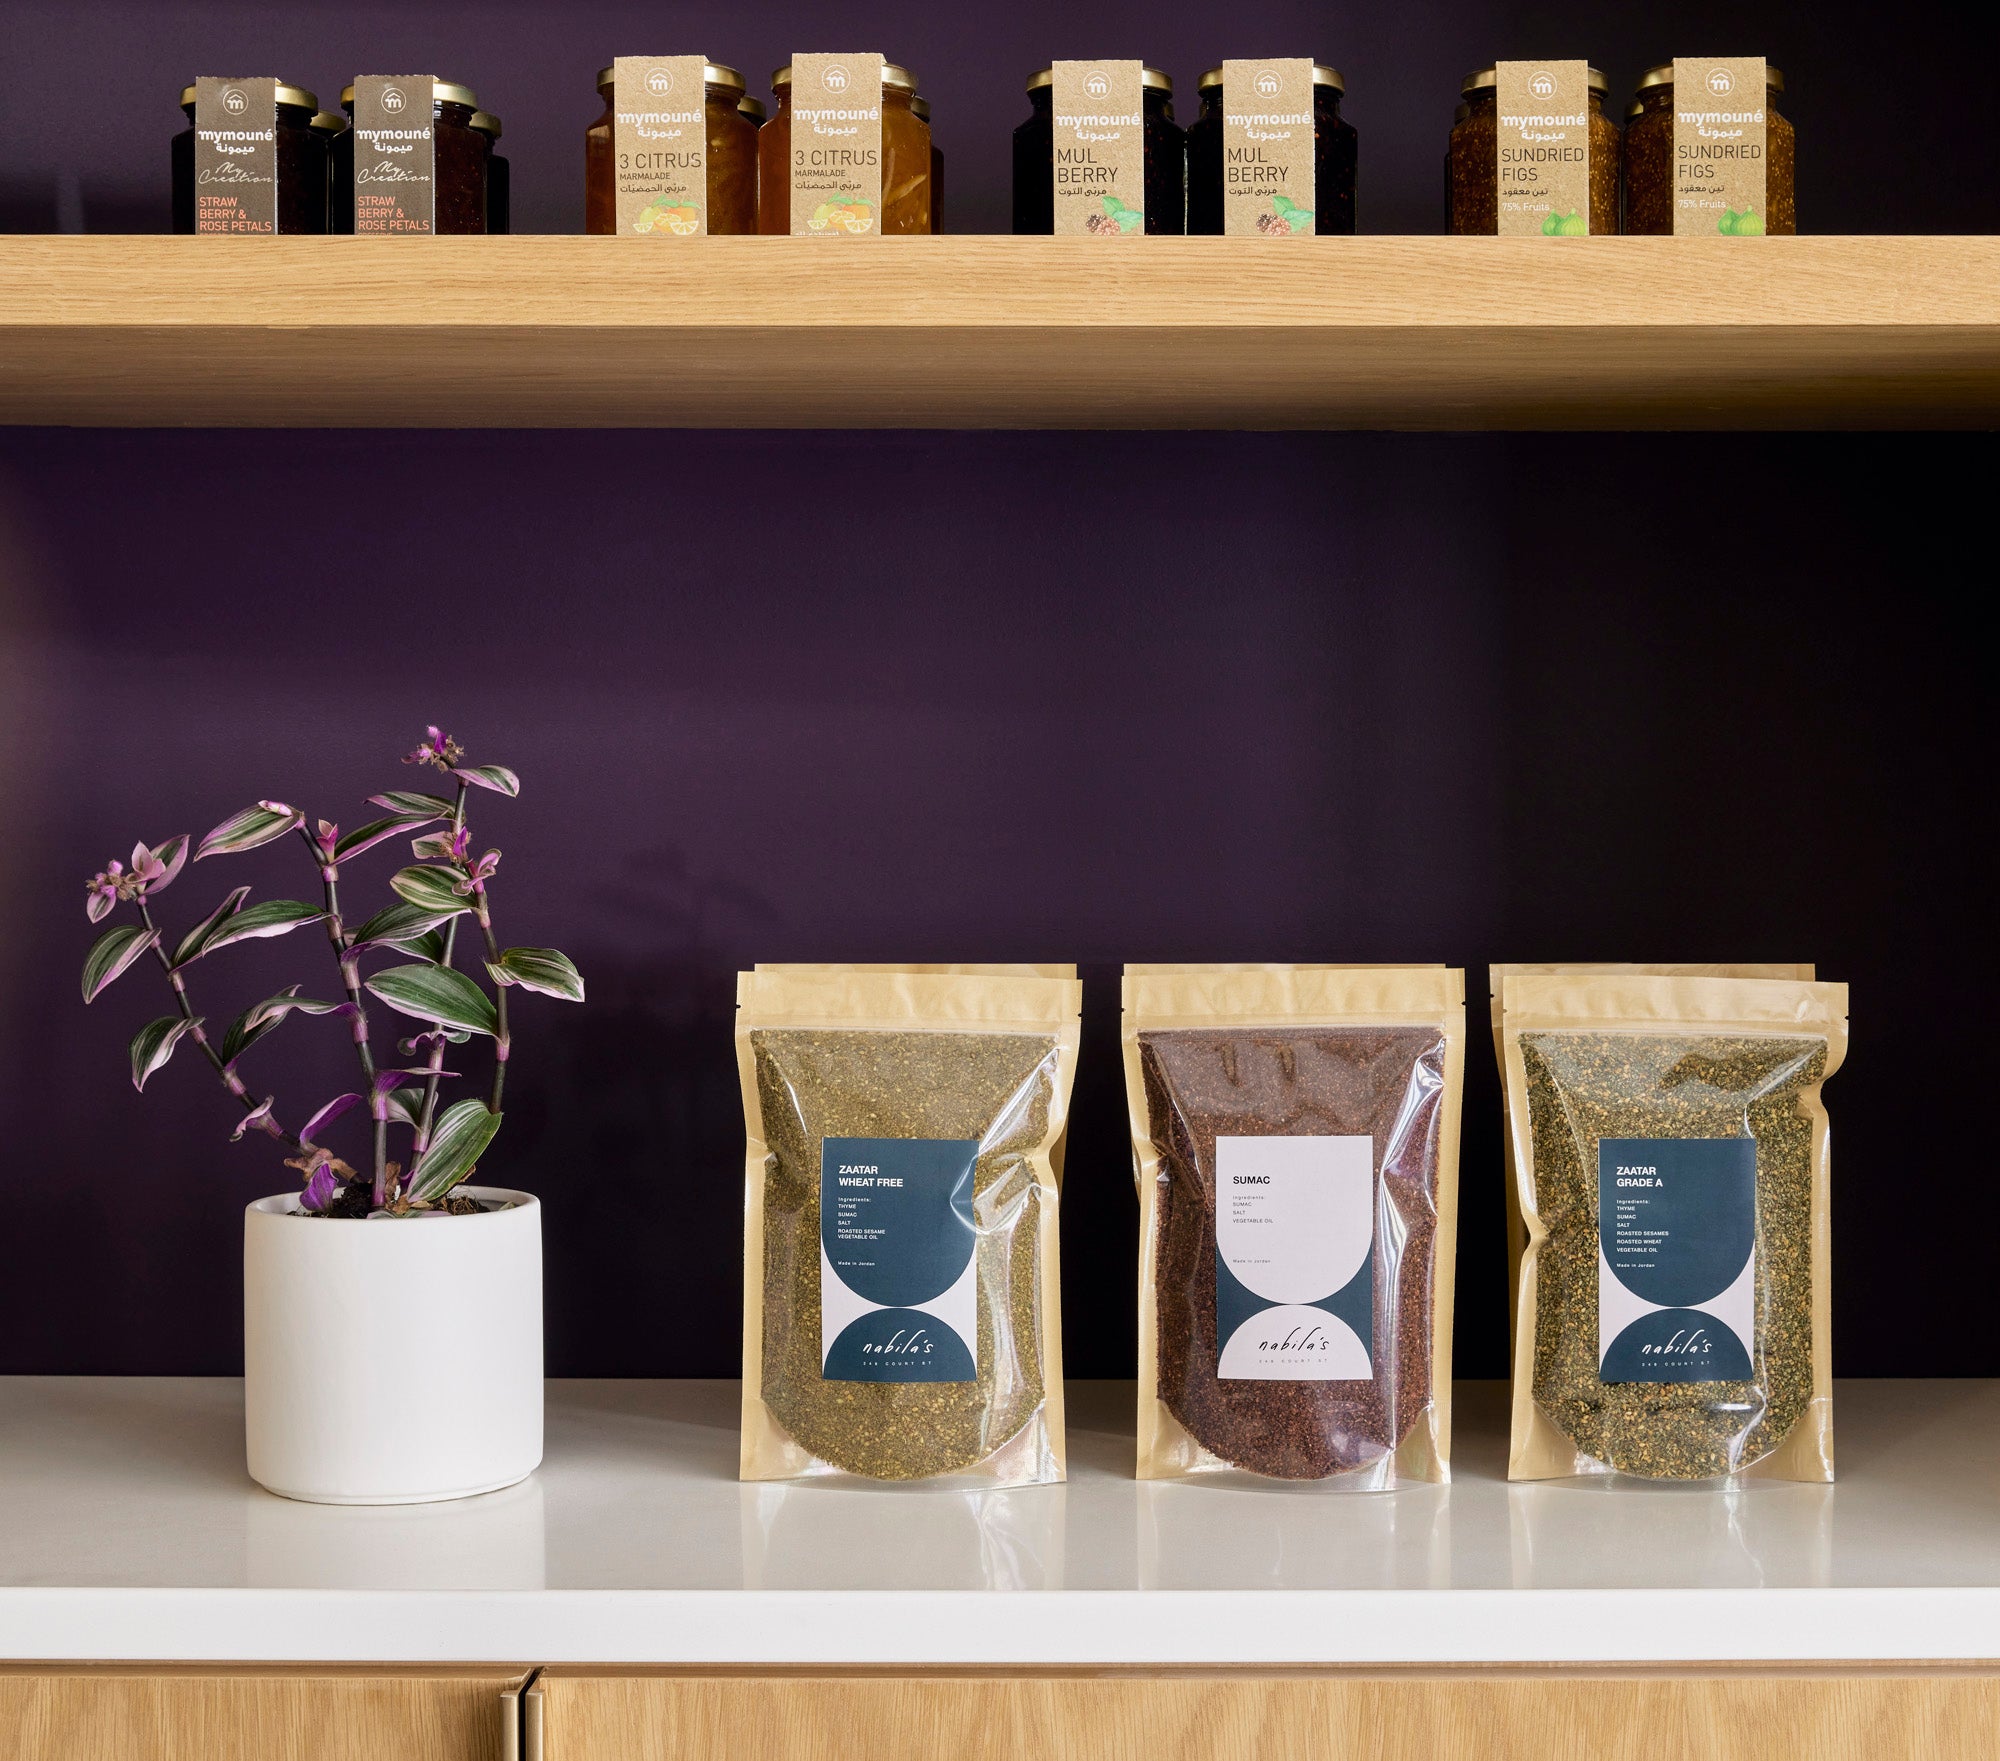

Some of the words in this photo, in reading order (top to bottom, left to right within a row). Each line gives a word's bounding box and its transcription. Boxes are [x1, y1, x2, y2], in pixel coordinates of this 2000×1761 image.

[617, 109, 702, 127] mymouné
[794, 107, 878, 124] mymouné
[1056, 112, 1140, 130] mymouné
[1226, 111, 1311, 129] mymouné
[1501, 112, 1586, 130] mymouné
[1678, 109, 1763, 127] mymouné
[198, 129, 273, 143] mymouné
[357, 127, 431, 142] mymouné
[637, 127, 681, 139] ميمونة
[813, 124, 858, 137] ميمونة
[1076, 129, 1120, 142] ميمونة
[1247, 128, 1290, 141] ميمونة
[1521, 130, 1565, 142] ميمونة
[1699, 126, 1743, 139] ميمونة
[216, 142, 255, 155] ميمونة
[374, 142, 413, 153] ميمونة
[1678, 145, 1761, 159] SUNDRIED
[619, 153, 629, 169] 3
[635, 152, 702, 169] CITRUS
[795, 150, 805, 166] 3
[811, 150, 877, 166] CITRUS
[1057, 148, 1097, 164] MUL
[1228, 148, 1268, 163] MUL
[1501, 148, 1584, 162] SUNDRIED
[215, 162, 243, 177] My
[374, 161, 401, 176] My
[795, 169, 846, 177] MARMALADE
[1058, 167, 1118, 183] BERRY
[1228, 166, 1288, 182] BERRY
[1502, 168, 1538, 181] FIGS
[1679, 164, 1714, 178] FIGS
[199, 170, 273, 184] Creation
[357, 169, 430, 184] Creation
[620, 172, 671, 180] MARMALADE
[199, 197, 237, 207] STRAW
[358, 196, 395, 206] STRAW
[1502, 202, 1521, 211] 75%
[1523, 202, 1550, 211] Fruits
[1678, 199, 1697, 209] 75%
[1699, 199, 1726, 209] Fruits
[200, 209, 235, 219] BERRY
[238, 209, 246, 219] &
[358, 208, 394, 218] BERRY
[396, 208, 404, 218] &
[200, 221, 228, 231] ROSE
[232, 221, 272, 231] PETALS
[359, 220, 386, 230] ROSE
[390, 220, 430, 231] PETALS
[839, 1165, 878, 1175] ZAATAR
[1616, 1166, 1657, 1175] ZAATAR
[839, 1178, 875, 1187] WHEAT
[877, 1178, 904, 1187] FREE
[1233, 1175, 1271, 1185] SUMAC
[1617, 1178, 1653, 1187] GRADE
[1655, 1178, 1663, 1187] A
[837, 1196, 872, 1204] Ingredients:
[862, 1330, 934, 1354] nabila's
[1259, 1326, 1330, 1351] nabila's
[1642, 1329, 1712, 1354] nabila's
